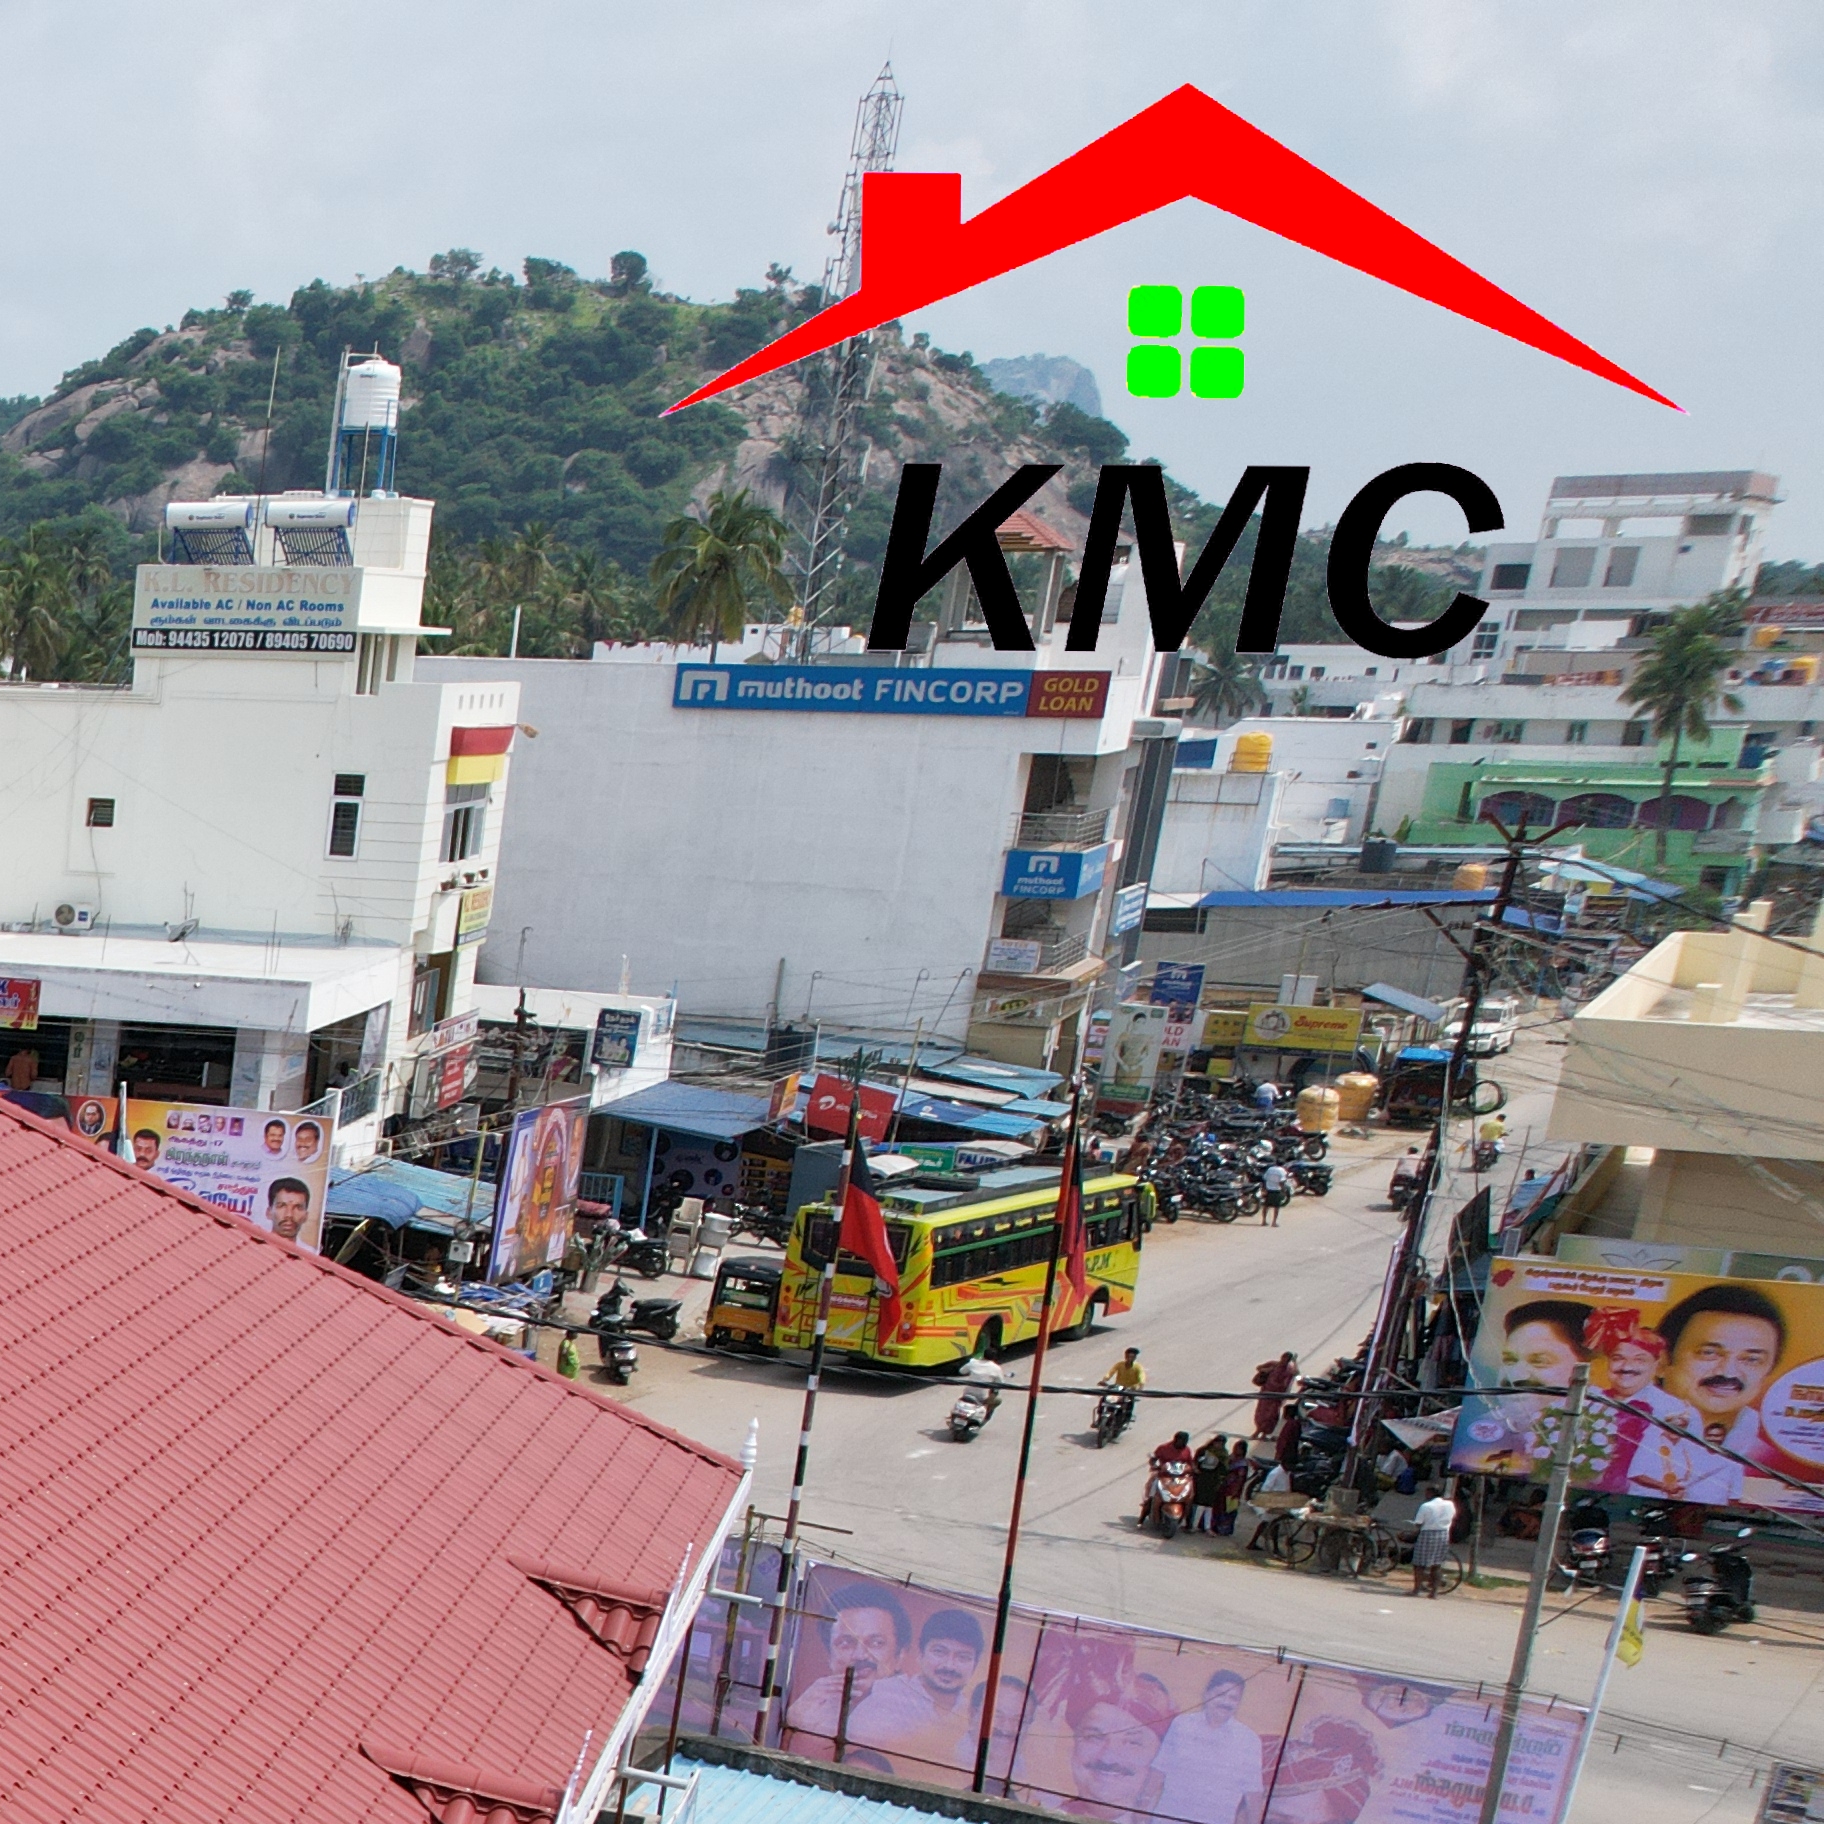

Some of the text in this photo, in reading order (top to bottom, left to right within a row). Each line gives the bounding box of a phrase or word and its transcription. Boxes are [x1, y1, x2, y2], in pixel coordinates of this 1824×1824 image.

[143, 570, 356, 596] K.L. RESIDENCY
[150, 598, 212, 611] Available
[215, 599, 234, 611] AC
[245, 600, 272, 611] Non
[275, 600, 295, 612] AC
[299, 600, 345, 613] Rooms
[135, 630, 354, 651] Mob: 94435 12076 / 89405 70690
[737, 677, 1025, 706] muthoot FINCORP
[1042, 677, 1100, 693] GOLD
[1038, 695, 1094, 712] LOAN
[1012, 885, 1066, 895] FINCORP
[1293, 1015, 1349, 1031] Supreme
